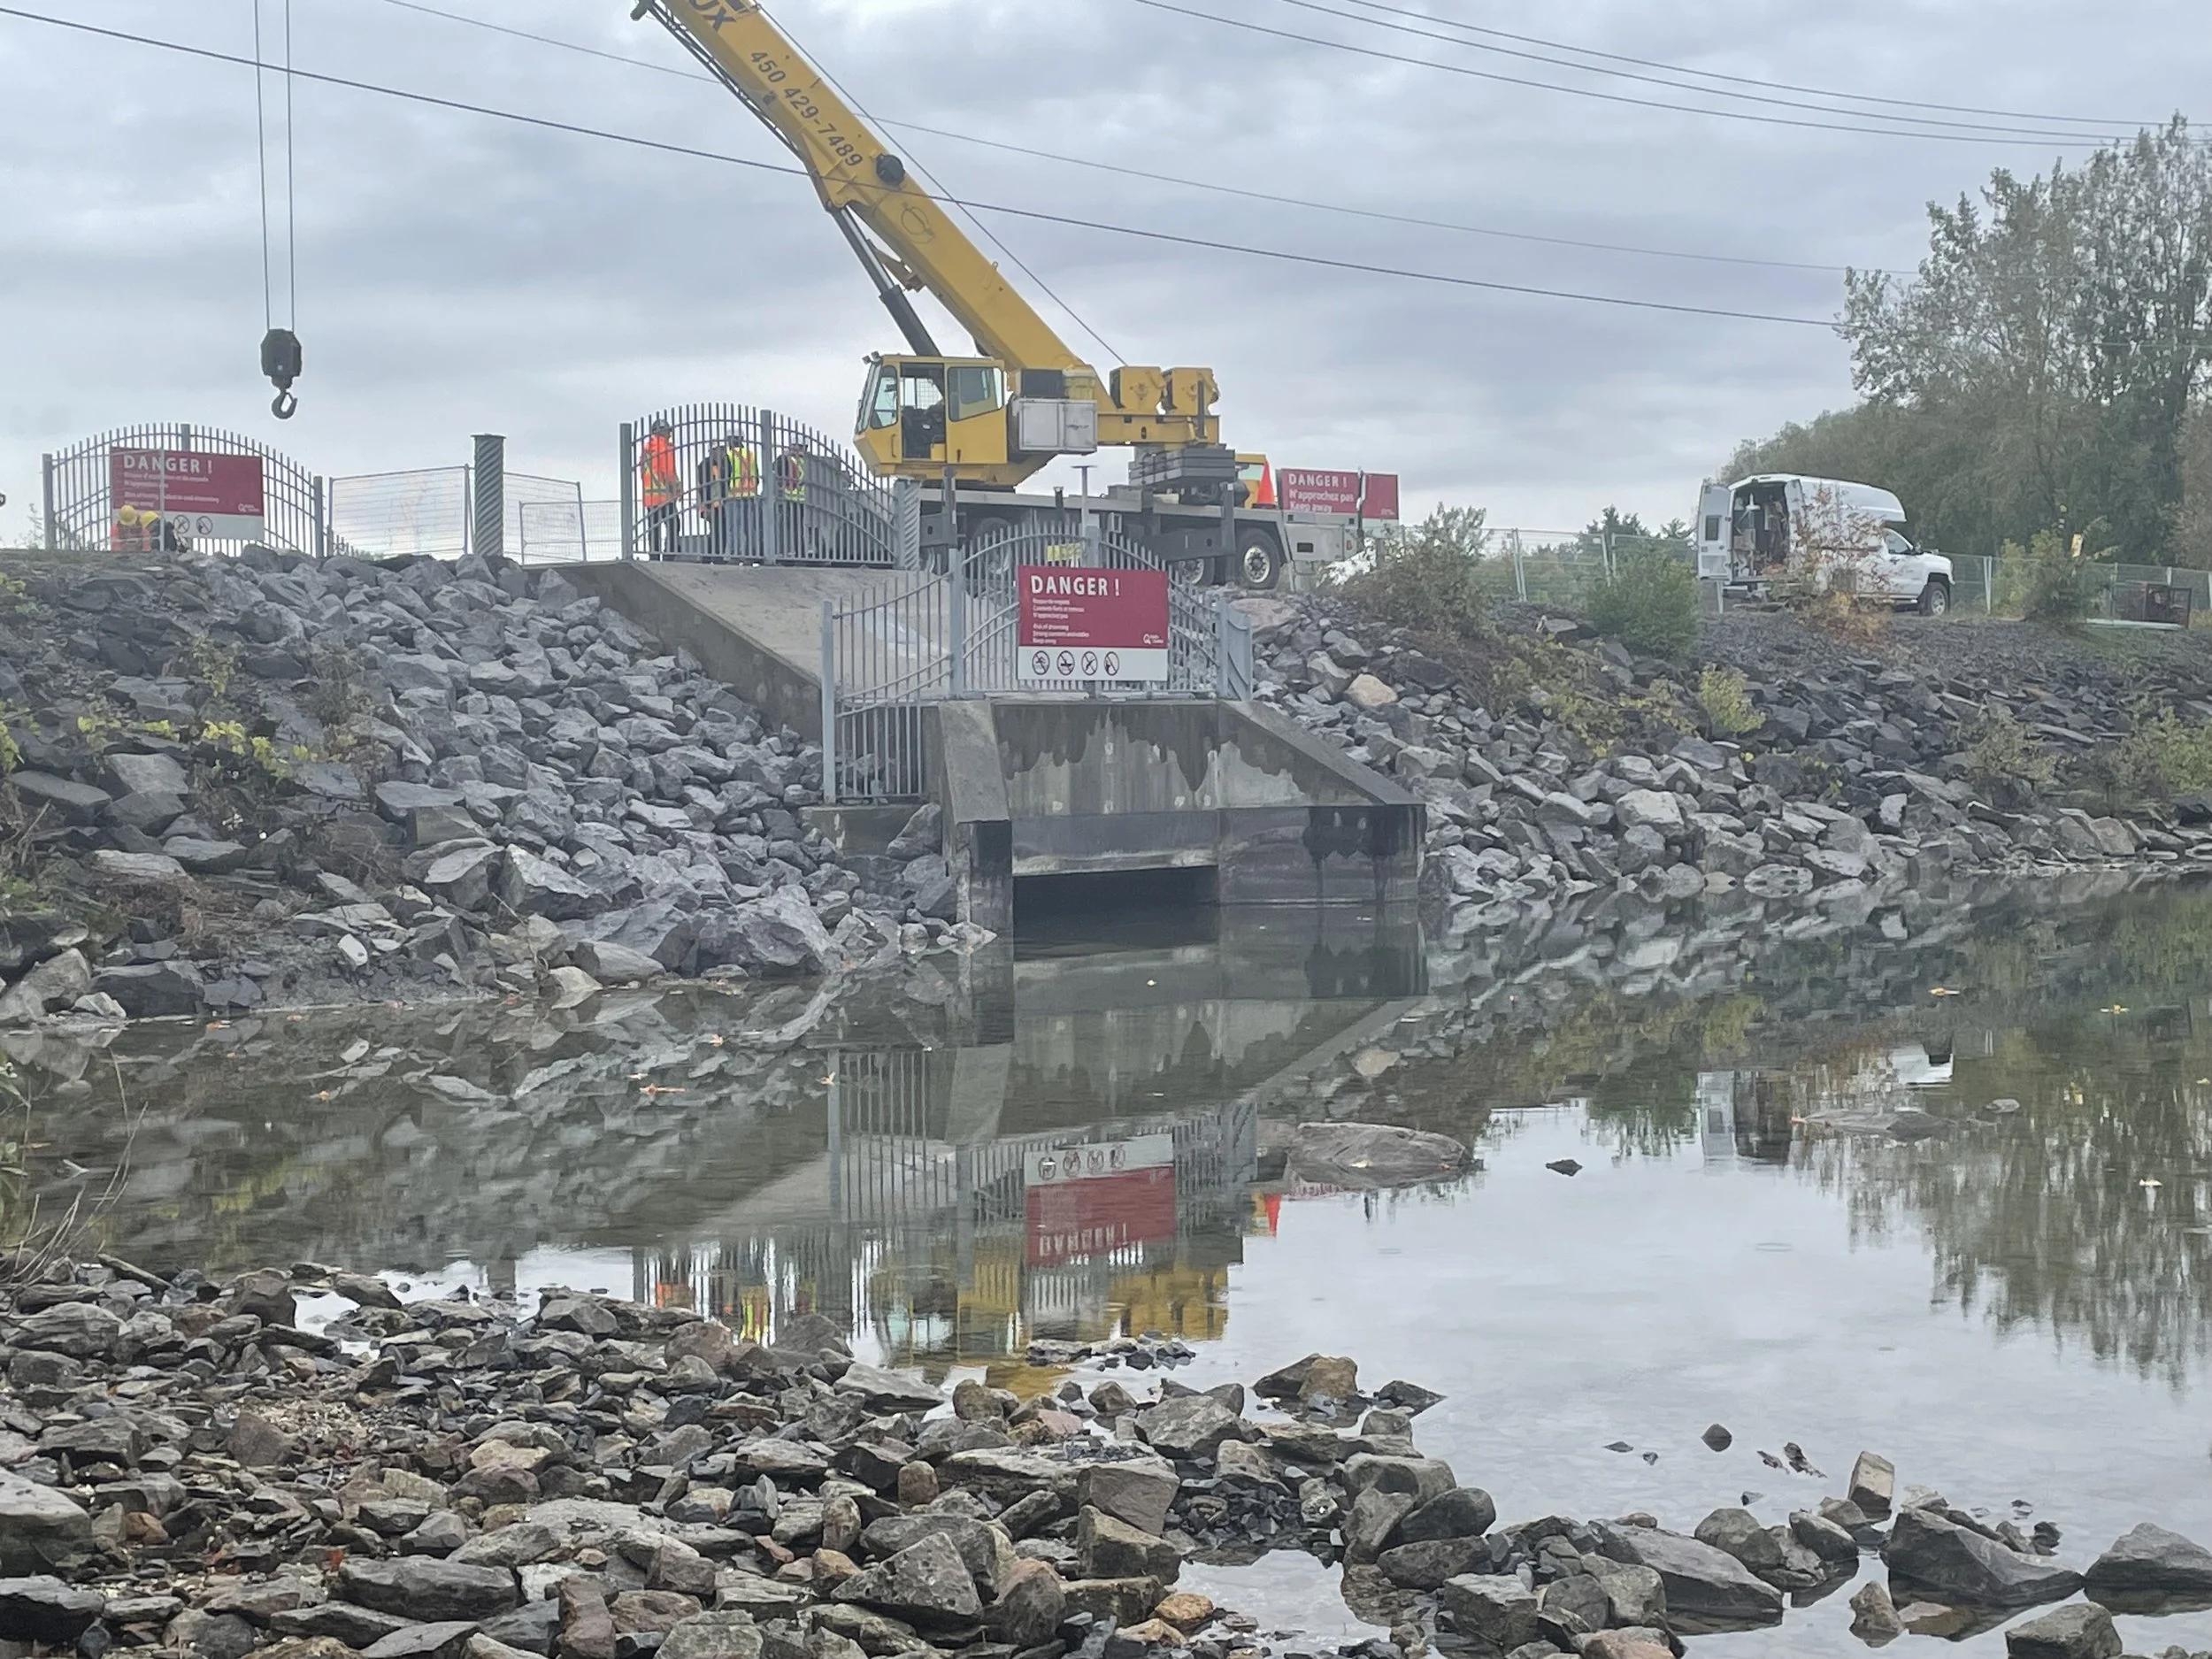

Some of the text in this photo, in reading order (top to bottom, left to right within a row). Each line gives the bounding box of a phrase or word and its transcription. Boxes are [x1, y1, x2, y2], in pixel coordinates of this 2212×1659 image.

[750, 50, 864, 166] 450 429-7489
[124, 455, 201, 473] DANGER
[1288, 473, 1339, 487] DANGER
[1031, 575, 1120, 596] DANGER !
